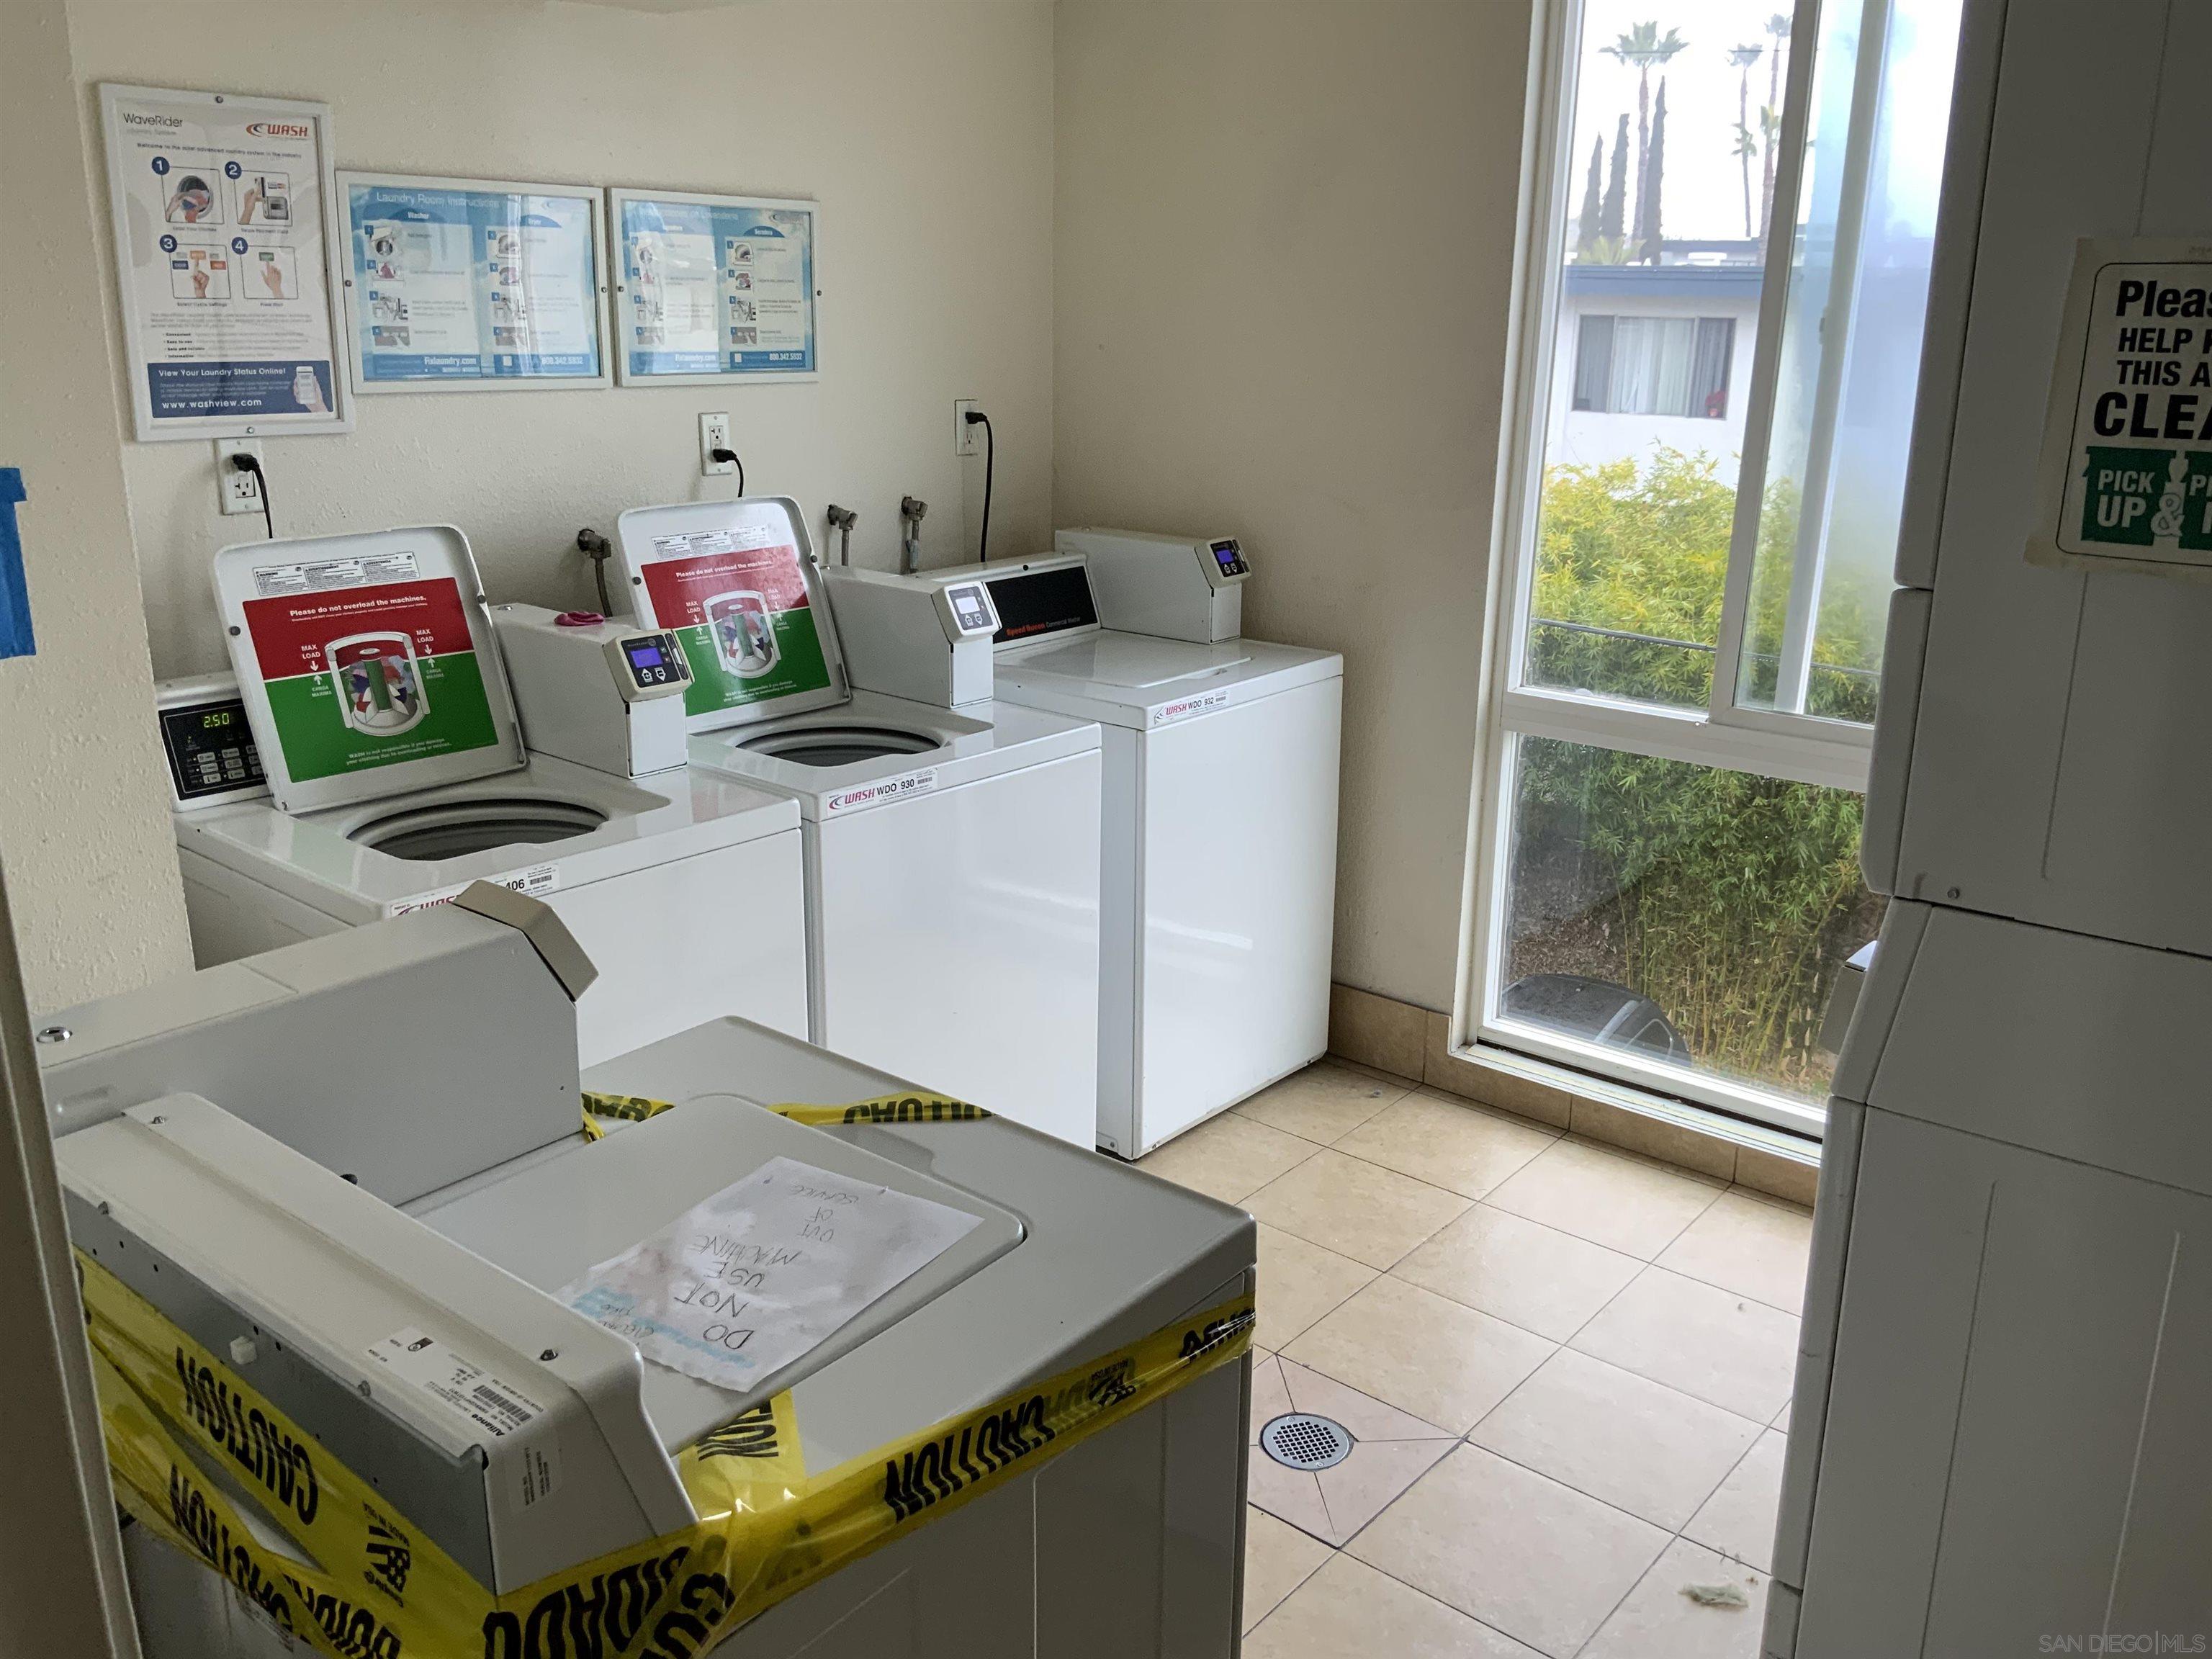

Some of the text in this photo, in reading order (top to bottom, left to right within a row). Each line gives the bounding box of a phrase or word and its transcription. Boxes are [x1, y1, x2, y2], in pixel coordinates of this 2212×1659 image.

[123, 113, 183, 127] WaveRider
[267, 124, 308, 137] WASH
[157, 161, 163, 170] 1
[229, 166, 238, 175] 2
[164, 238, 173, 248] 3
[235, 240, 244, 251] 4
[2116, 280, 2212, 318] Plea
[2118, 328, 2193, 354] HELP
[2117, 360, 2181, 387] THIS
[162, 399, 262, 409] www.washview.com
[2098, 469, 2157, 495] PICK
[2097, 495, 2147, 528] UP
[714, 565, 737, 573] overload
[289, 608, 316, 617] Please
[343, 601, 375, 611] overload
[390, 595, 426, 604] machines.
[1166, 697, 1214, 715] WASH WDO 932
[204, 713, 230, 728] 2.50
[845, 788, 876, 804] WASH
[876, 783, 897, 796] WDO
[901, 778, 915, 790] 930
[505, 878, 525, 891] 406
[805, 1207, 834, 1223] OF
[796, 1223, 835, 1242] OUT
[686, 1233, 803, 1267] MACHINE
[709, 1262, 765, 1289] USE
[674, 1281, 752, 1319] NOT
[703, 1323, 756, 1351] DO
[470, 1413, 505, 1436] Alliance
[176, 1346, 318, 1526] CAUTION
[885, 1396, 1056, 1524] CAUTION
